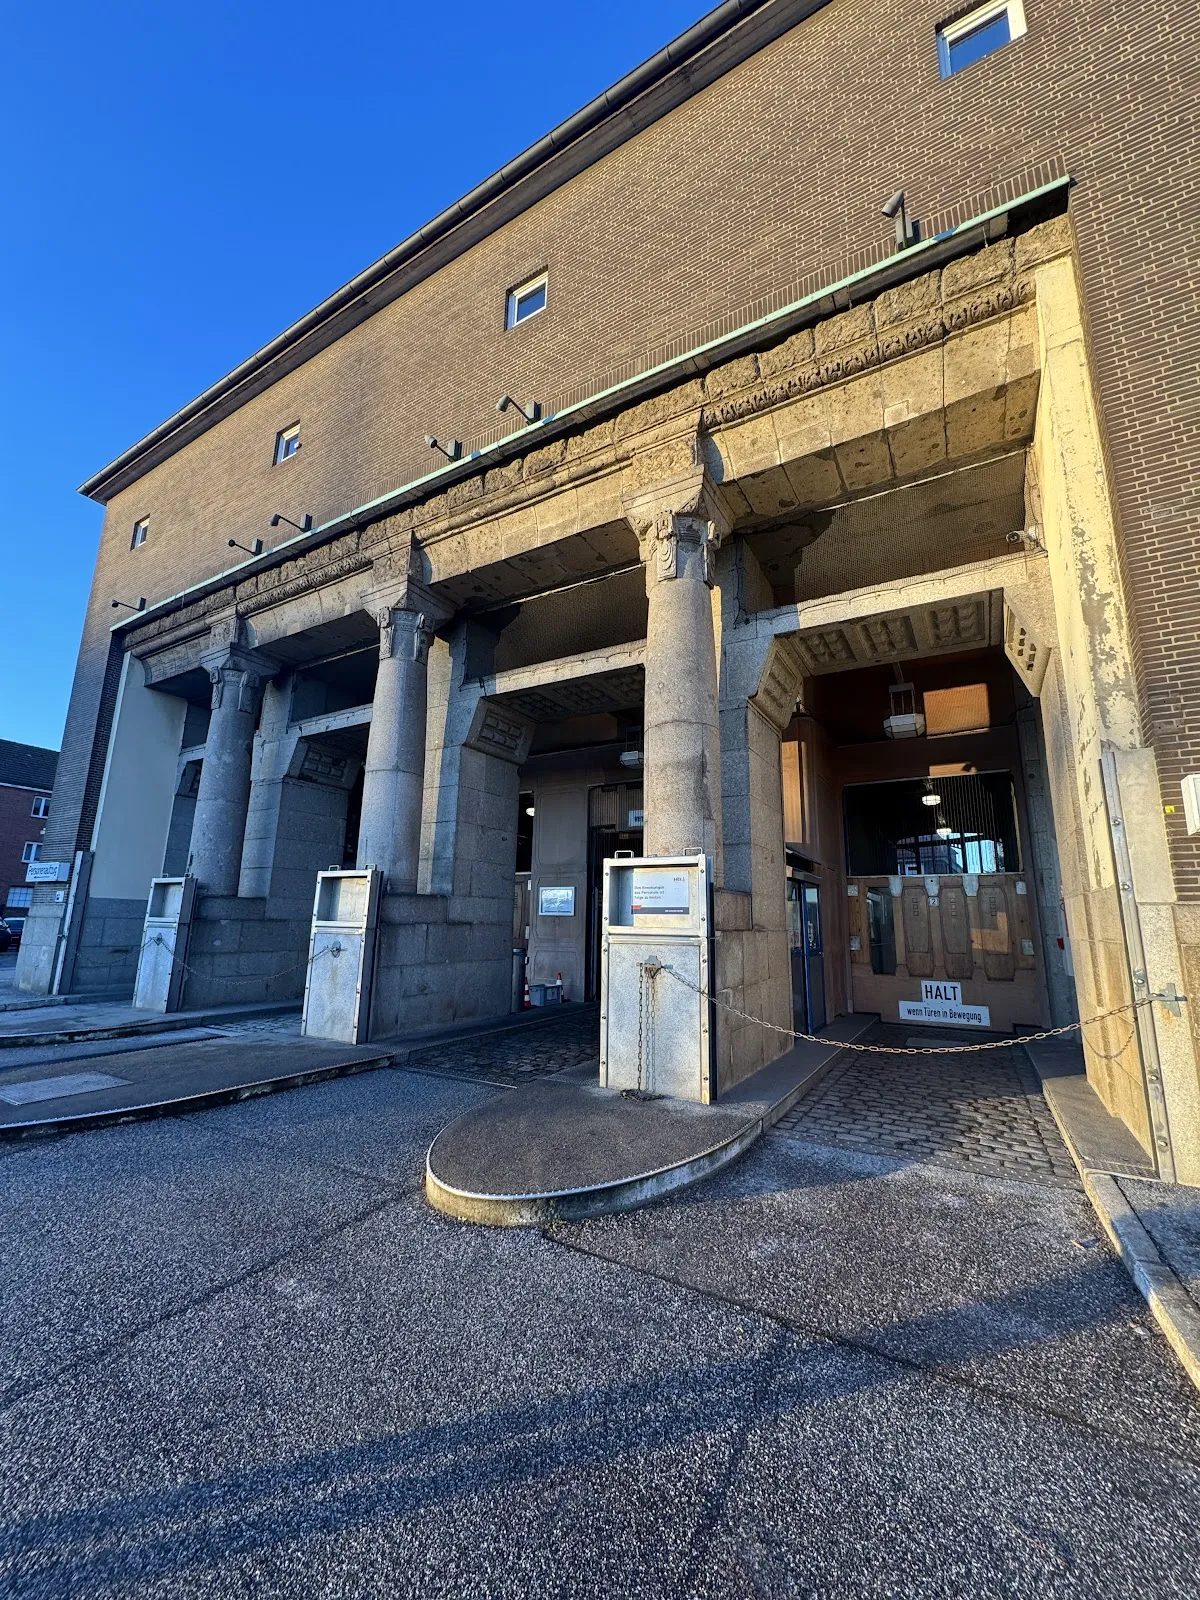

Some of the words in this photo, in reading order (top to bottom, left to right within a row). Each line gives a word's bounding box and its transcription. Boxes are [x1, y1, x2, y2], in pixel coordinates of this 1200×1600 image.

[925, 984, 958, 1001] HALT
[907, 1007, 923, 1017] wenn
[924, 1006, 941, 1018] Türen
[942, 1008, 948, 1018] in
[949, 1008, 982, 1024] Bewegung
